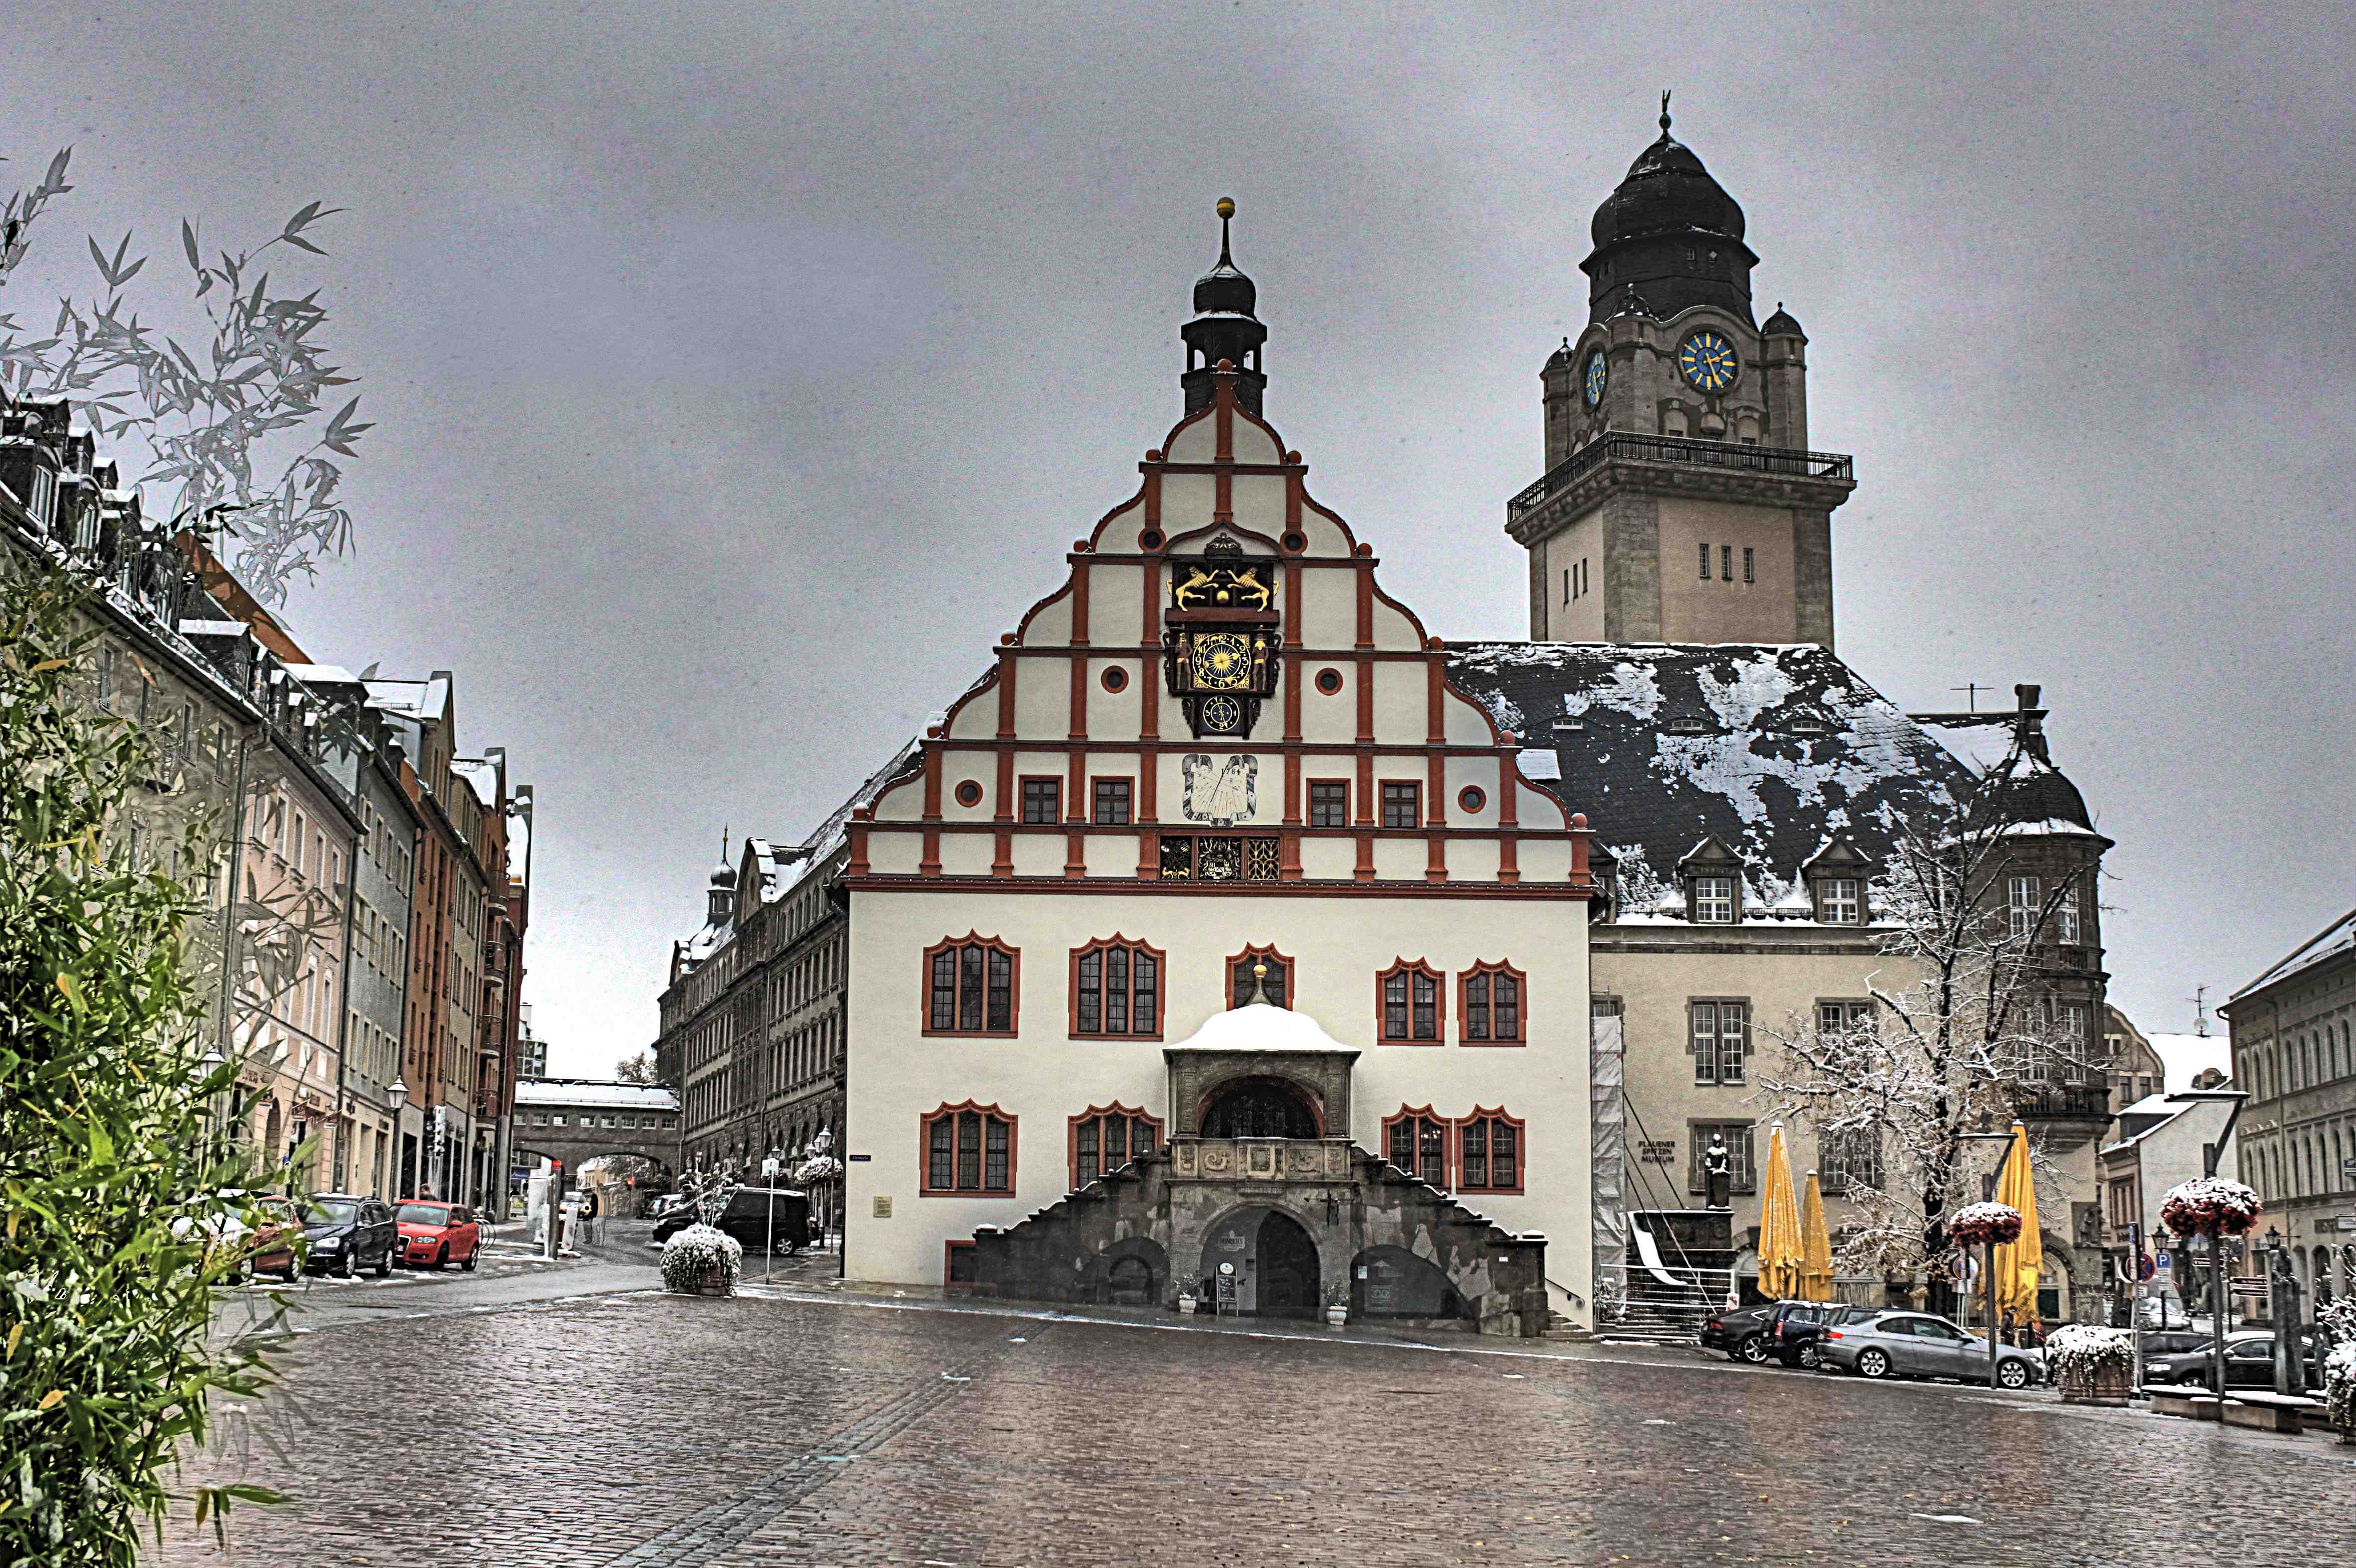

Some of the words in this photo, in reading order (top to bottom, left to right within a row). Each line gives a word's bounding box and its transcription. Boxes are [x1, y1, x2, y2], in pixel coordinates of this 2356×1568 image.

[1219, 634, 1227, 643] 12
[1230, 637, 1235, 646] 1
[1197, 645, 1206, 654] 10
[1239, 645, 1246, 654] 2
[1195, 656, 1202, 665] 9
[1198, 668, 1205, 677] 8
[1238, 668, 1245, 677] 4
[1207, 677, 1212, 685] 7
[1218, 679, 1225, 688] 6
[2159, 1255, 2168, 1266] P
